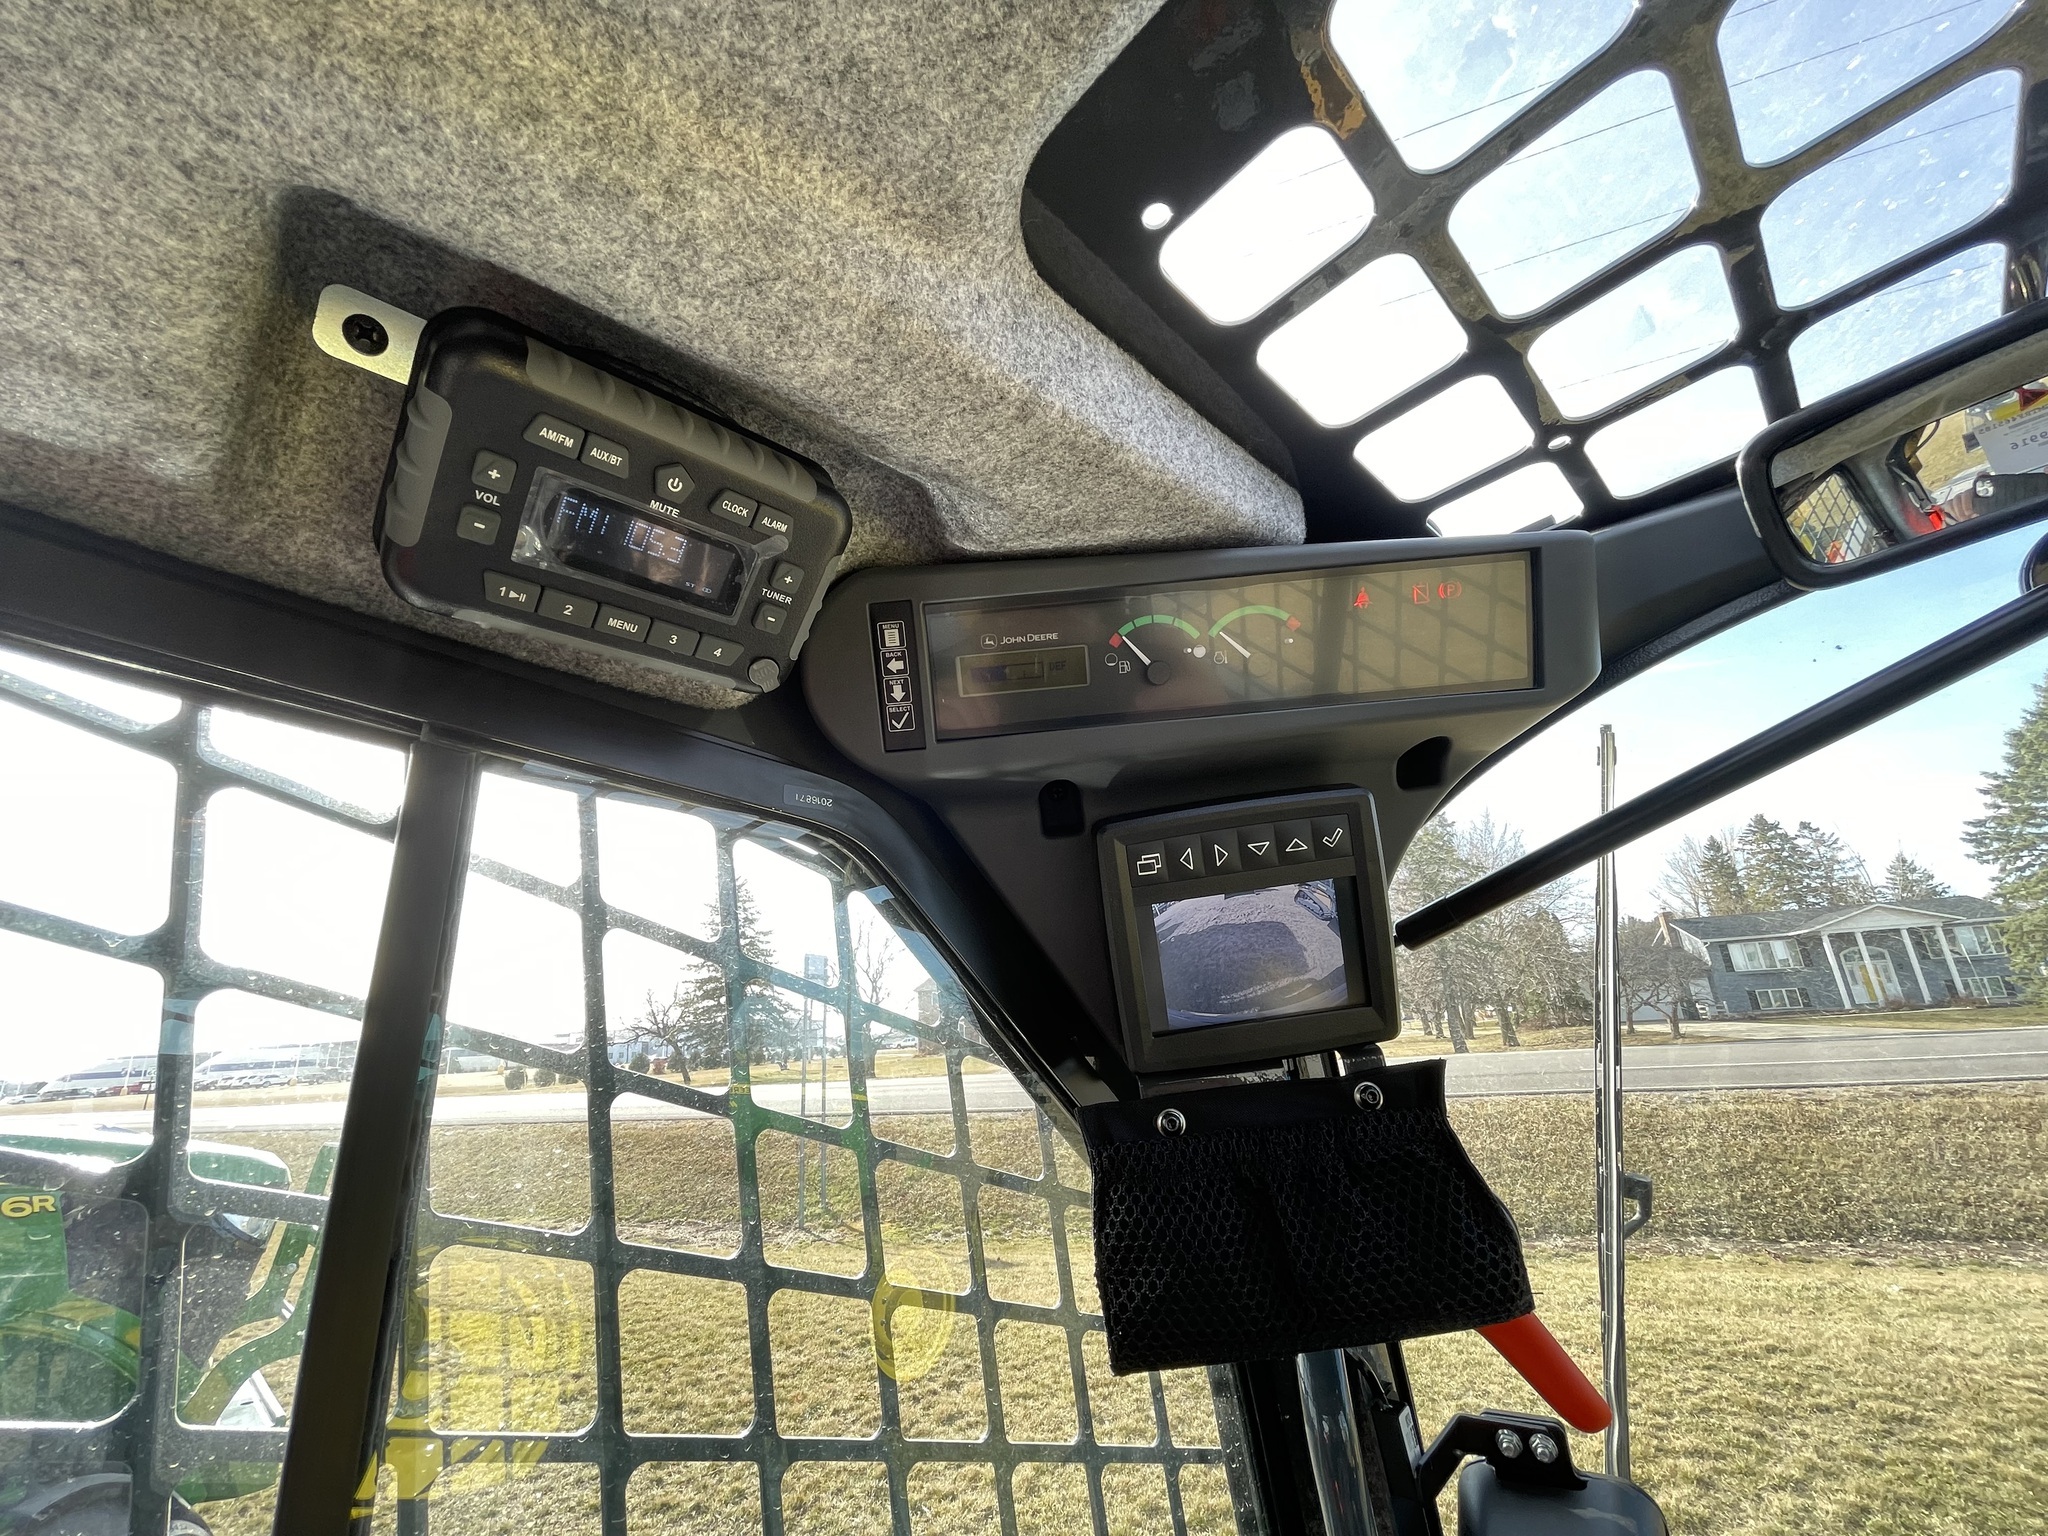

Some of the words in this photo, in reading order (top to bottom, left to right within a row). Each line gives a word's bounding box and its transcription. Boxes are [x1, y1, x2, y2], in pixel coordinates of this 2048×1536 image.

[538, 427, 574, 448] AM/FM
[590, 447, 623, 467] AUX/BT
[475, 490, 501, 506] VOL
[649, 499, 681, 518] MUTE
[722, 500, 749, 518] CLOCK
[761, 516, 788, 533] ALARM
[623, 520, 687, 563] 105.3
[499, 586, 506, 597] 1
[761, 588, 792, 605] TUNER
[563, 605, 573, 616] 2
[607, 617, 638, 633] MENU
[669, 634, 678, 645] 3
[1000, 635, 1026, 645] JOHN
[1027, 633, 1059, 642] DEERE
[713, 647, 722, 657] 4
[1049, 660, 1067, 671] DEF
[1, 1195, 56, 1218] 6R
